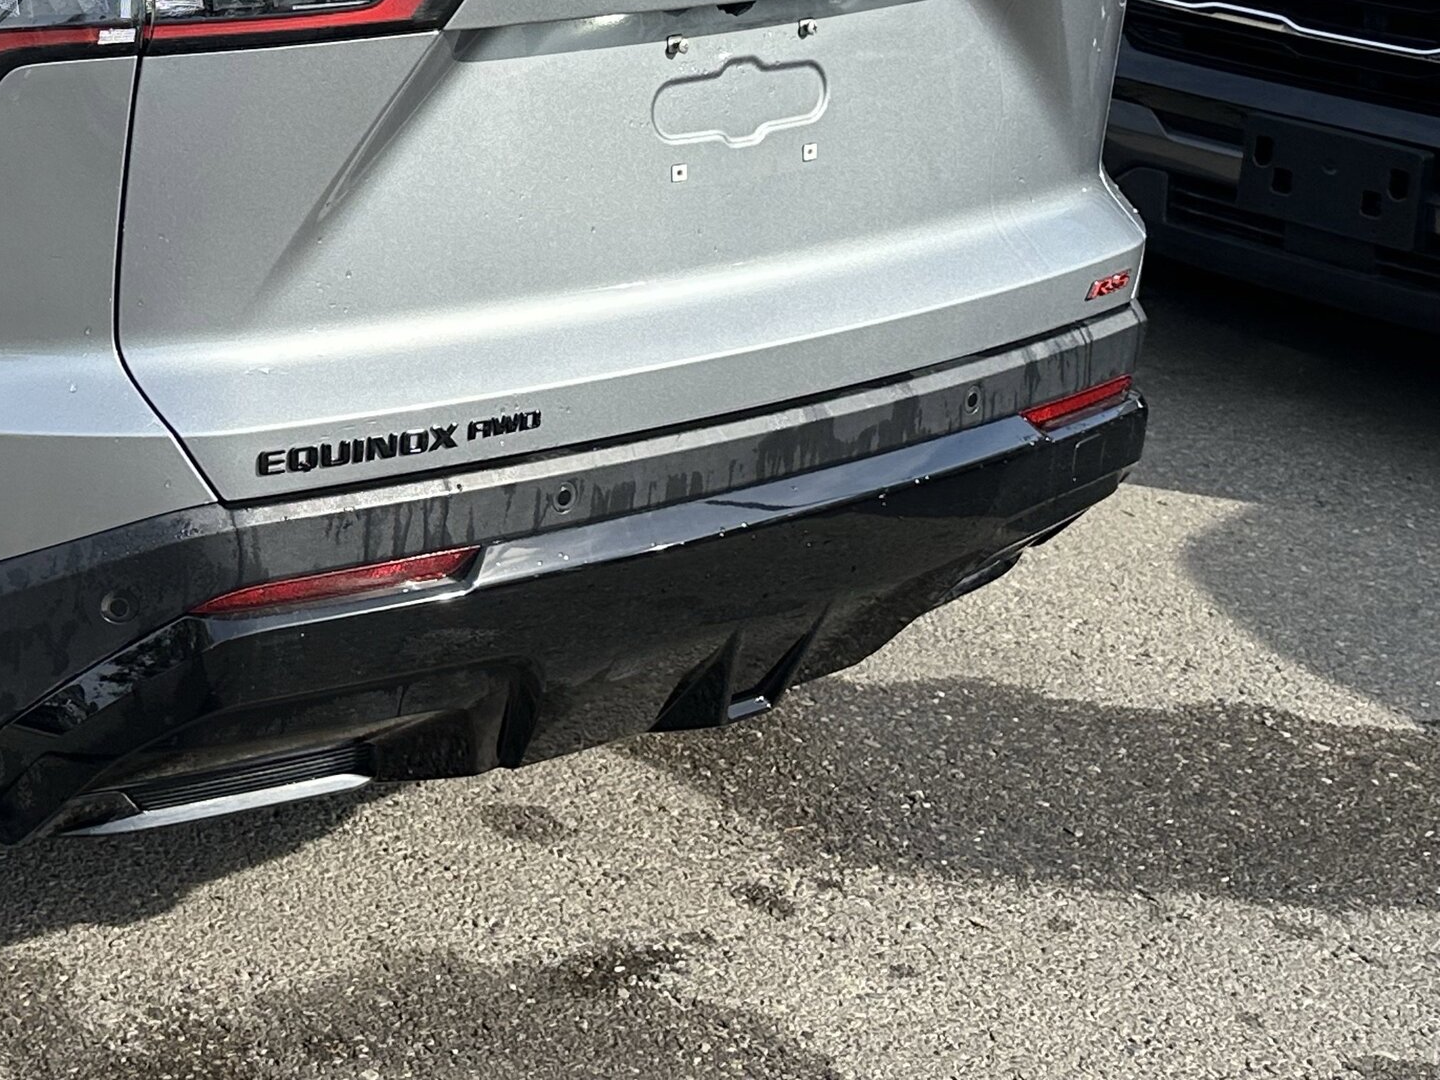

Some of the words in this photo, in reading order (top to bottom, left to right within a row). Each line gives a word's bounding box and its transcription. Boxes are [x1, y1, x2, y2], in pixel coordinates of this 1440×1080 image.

[1084, 268, 1132, 301] RS
[256, 421, 459, 477] EQUINOX
[466, 409, 542, 442] AWD
